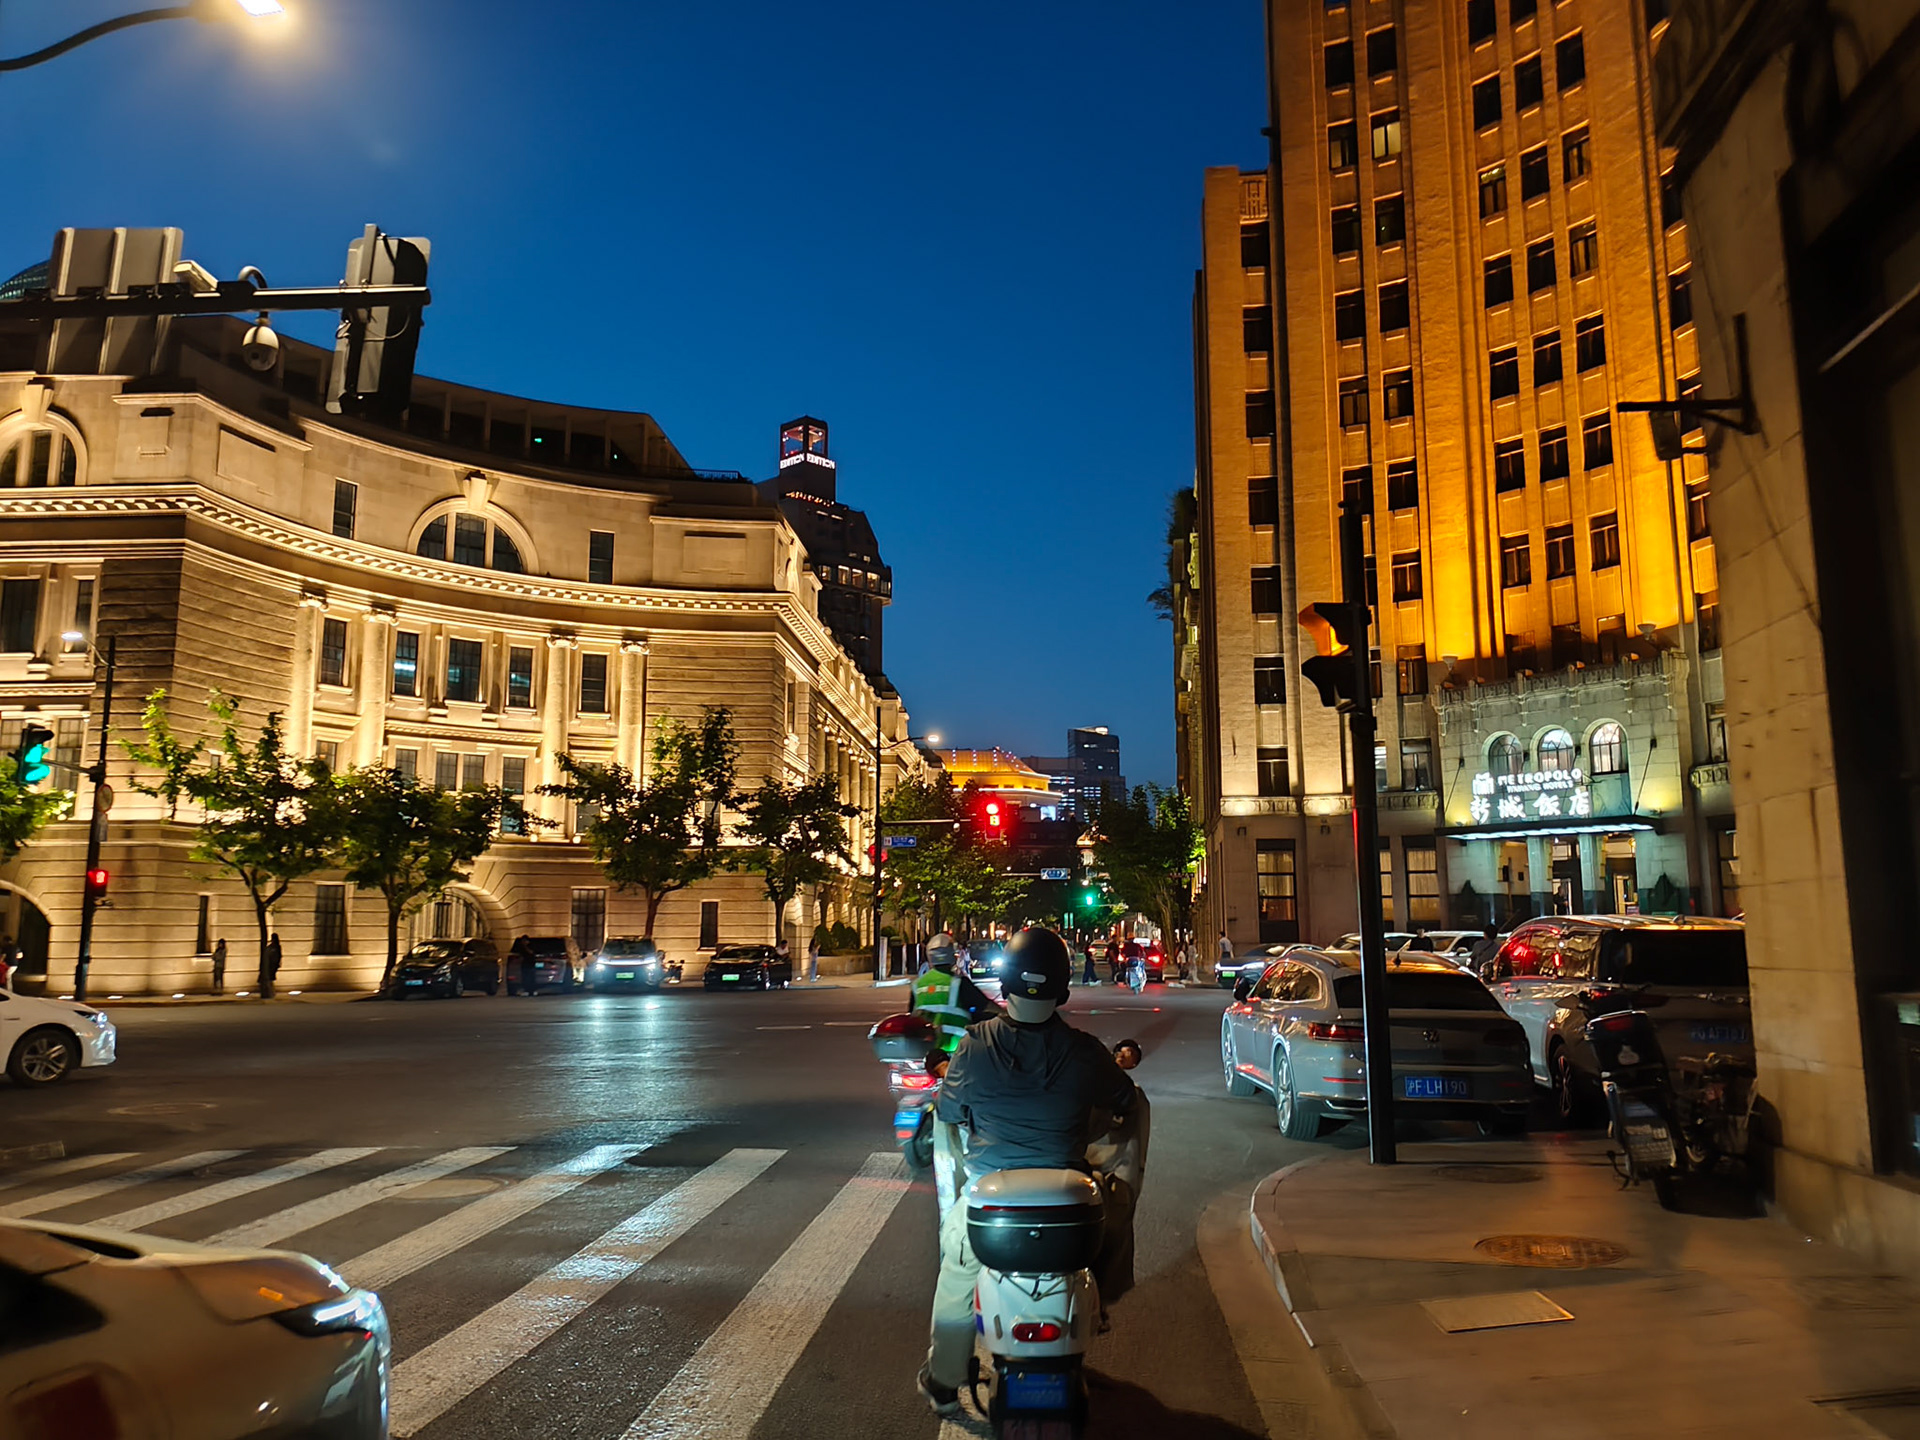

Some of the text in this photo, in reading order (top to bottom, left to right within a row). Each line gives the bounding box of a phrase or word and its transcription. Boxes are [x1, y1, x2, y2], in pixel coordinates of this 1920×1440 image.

[780, 453, 805, 469] EDITION
[806, 453, 835, 469] EDITION
[1497, 768, 1582, 785] METROPOLO
